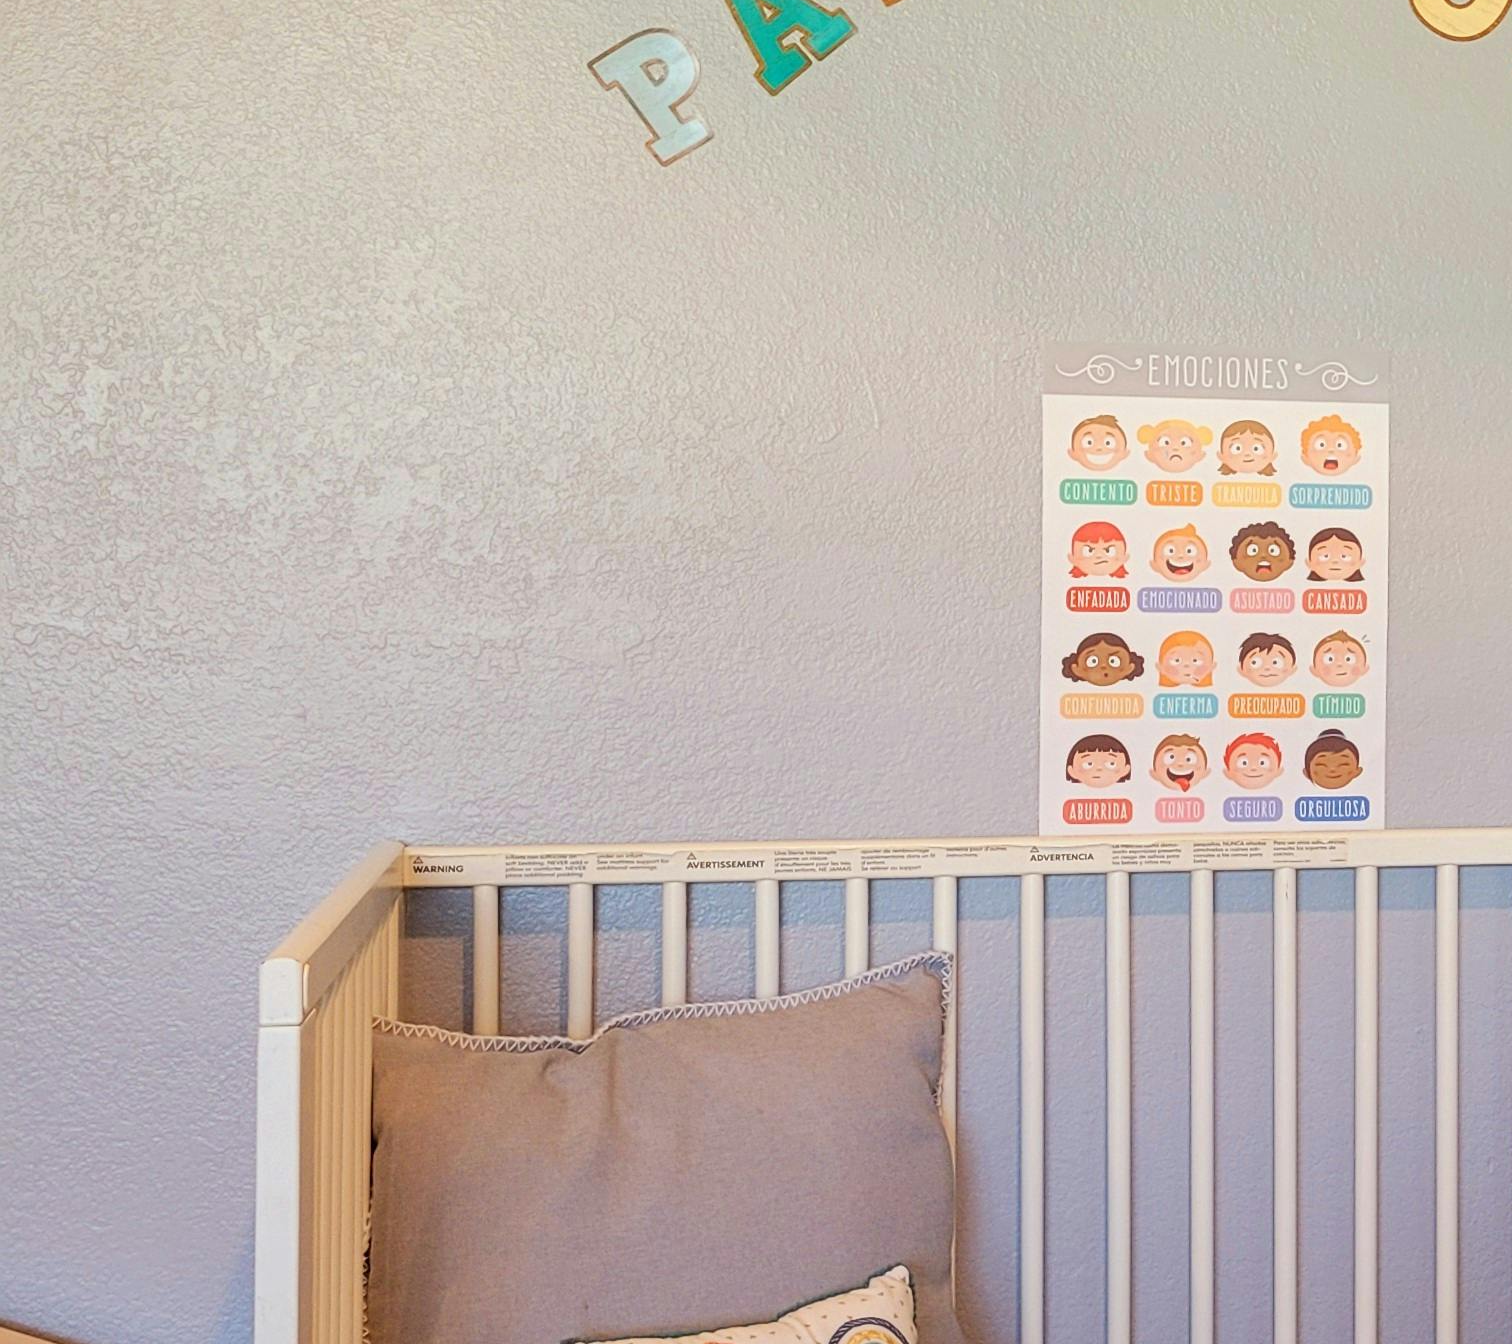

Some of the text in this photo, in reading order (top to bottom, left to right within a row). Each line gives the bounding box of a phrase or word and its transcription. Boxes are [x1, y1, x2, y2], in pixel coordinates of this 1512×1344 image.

[1147, 354, 1290, 390] EMOCIONES
[1064, 482, 1134, 502] CONTENTO
[1151, 483, 1197, 503] TRISTE
[1216, 485, 1278, 504] TRANQUILA
[1291, 487, 1370, 506] SORPRENDIDO
[1070, 590, 1128, 608] ENFADADA
[1142, 591, 1217, 609] EMOCIONADO
[1234, 592, 1291, 609] ASUSTADO
[1307, 592, 1364, 610] CANSADA
[1064, 697, 1140, 715] CONFUNDIDA
[1159, 697, 1213, 715] ENFERMA
[1233, 697, 1300, 714] PREOCUPADO
[1318, 696, 1360, 714] TÍMIDO
[1069, 802, 1128, 821] ABURRIDA
[1160, 800, 1201, 819] TONTO
[1229, 800, 1277, 818] SEGURO
[1299, 800, 1367, 818] ORGULLOSA
[686, 860, 766, 870] AVERTISSEMENT
[1030, 853, 1095, 863] ADVERTENCIA
[412, 864, 464, 874] WARNING
